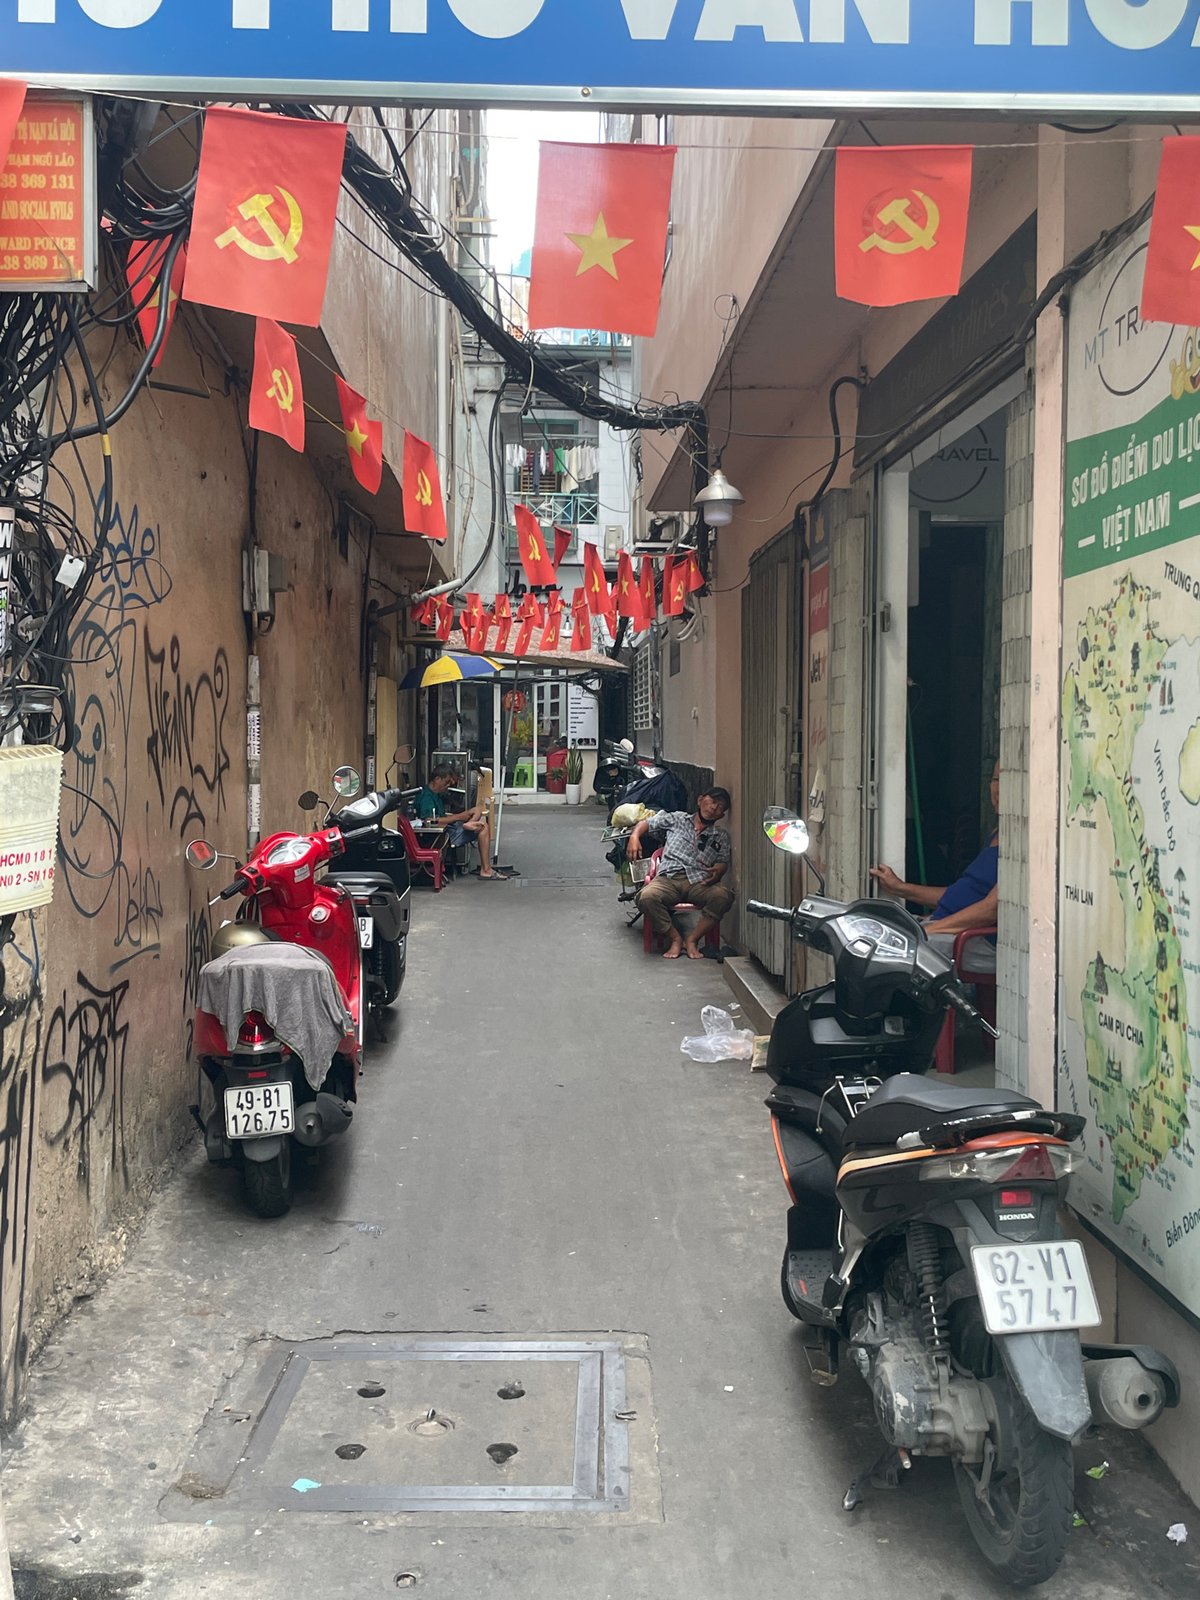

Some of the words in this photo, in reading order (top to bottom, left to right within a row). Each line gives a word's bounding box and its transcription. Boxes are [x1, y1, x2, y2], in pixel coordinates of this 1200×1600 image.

[7, 154, 31, 169] HẠM
[21, 173, 46, 190] 369
[51, 173, 75, 190] 131
[34, 237, 76, 251] POLICE
[23, 255, 48, 271] 369
[1084, 327, 1109, 370] MT
[1114, 305, 1144, 347] TR
[1151, 426, 1174, 472] DU
[1177, 411, 1200, 463] LỊC
[930, 447, 999, 462] RAVEL
[1134, 490, 1171, 538] NAM
[1163, 561, 1192, 593] TRUNG
[1098, 1011, 1114, 1032] CAM
[1115, 1018, 1125, 1038] PU
[1126, 1024, 1145, 1048] CHIA
[236, 1087, 281, 1111] 49-B1
[231, 1109, 290, 1135] 126.75
[998, 1212, 1035, 1222] HONDA
[989, 1246, 1073, 1285] 62-V1
